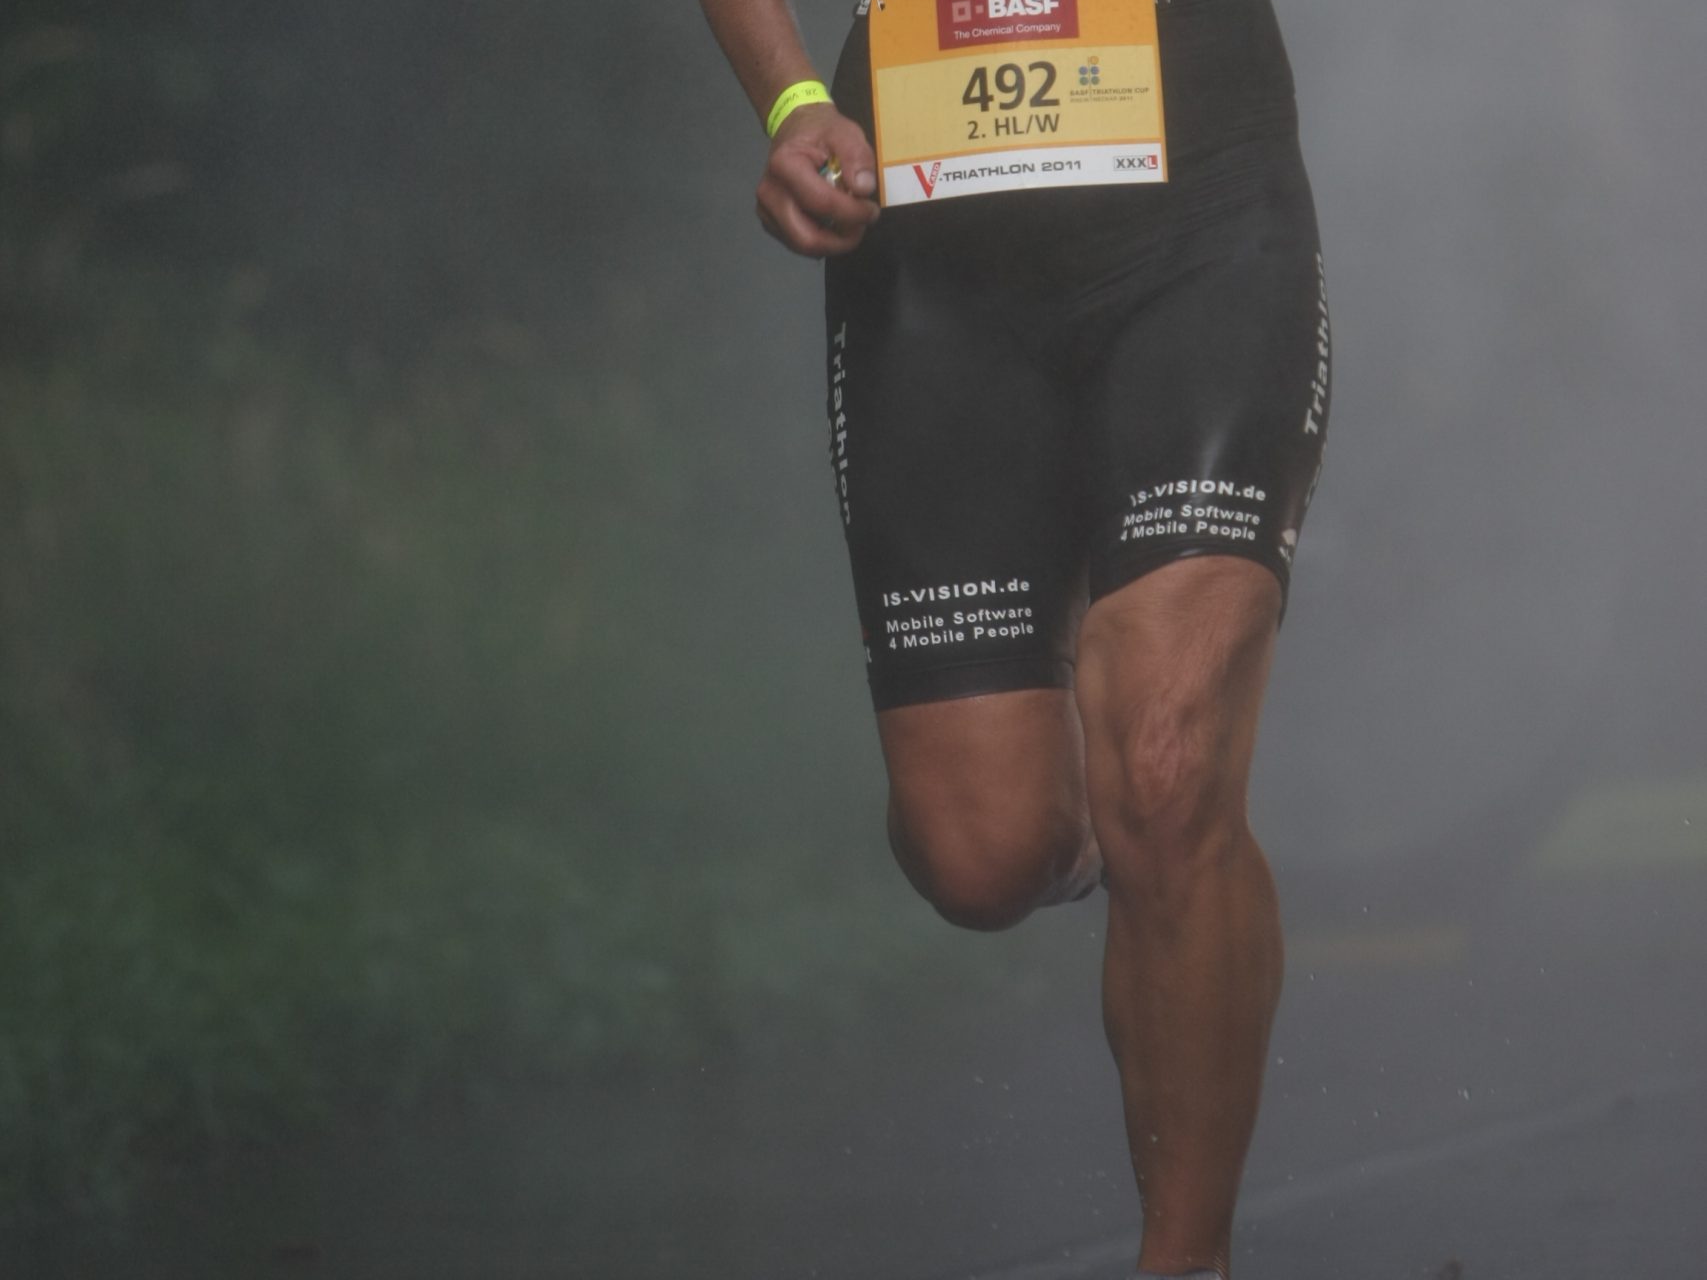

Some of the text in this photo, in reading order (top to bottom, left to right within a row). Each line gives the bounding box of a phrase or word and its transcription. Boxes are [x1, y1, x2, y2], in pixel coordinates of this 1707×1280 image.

[954, 23, 1061, 40] The Chemical Company
[962, 60, 1060, 113] 492
[967, 114, 1060, 140] 2. HL/W
[1041, 160, 1082, 172] 2011
[1116, 155, 1158, 170] XXXL
[1130, 479, 1266, 507] IS-VISION.de
[1123, 504, 1260, 527] Mobile Software
[1120, 521, 1256, 542] 4 Mobile People
[883, 578, 1030, 607] IS-VISION.de
[886, 605, 1033, 634] Mobile Software
[889, 622, 1034, 650] 4 Mobile People
